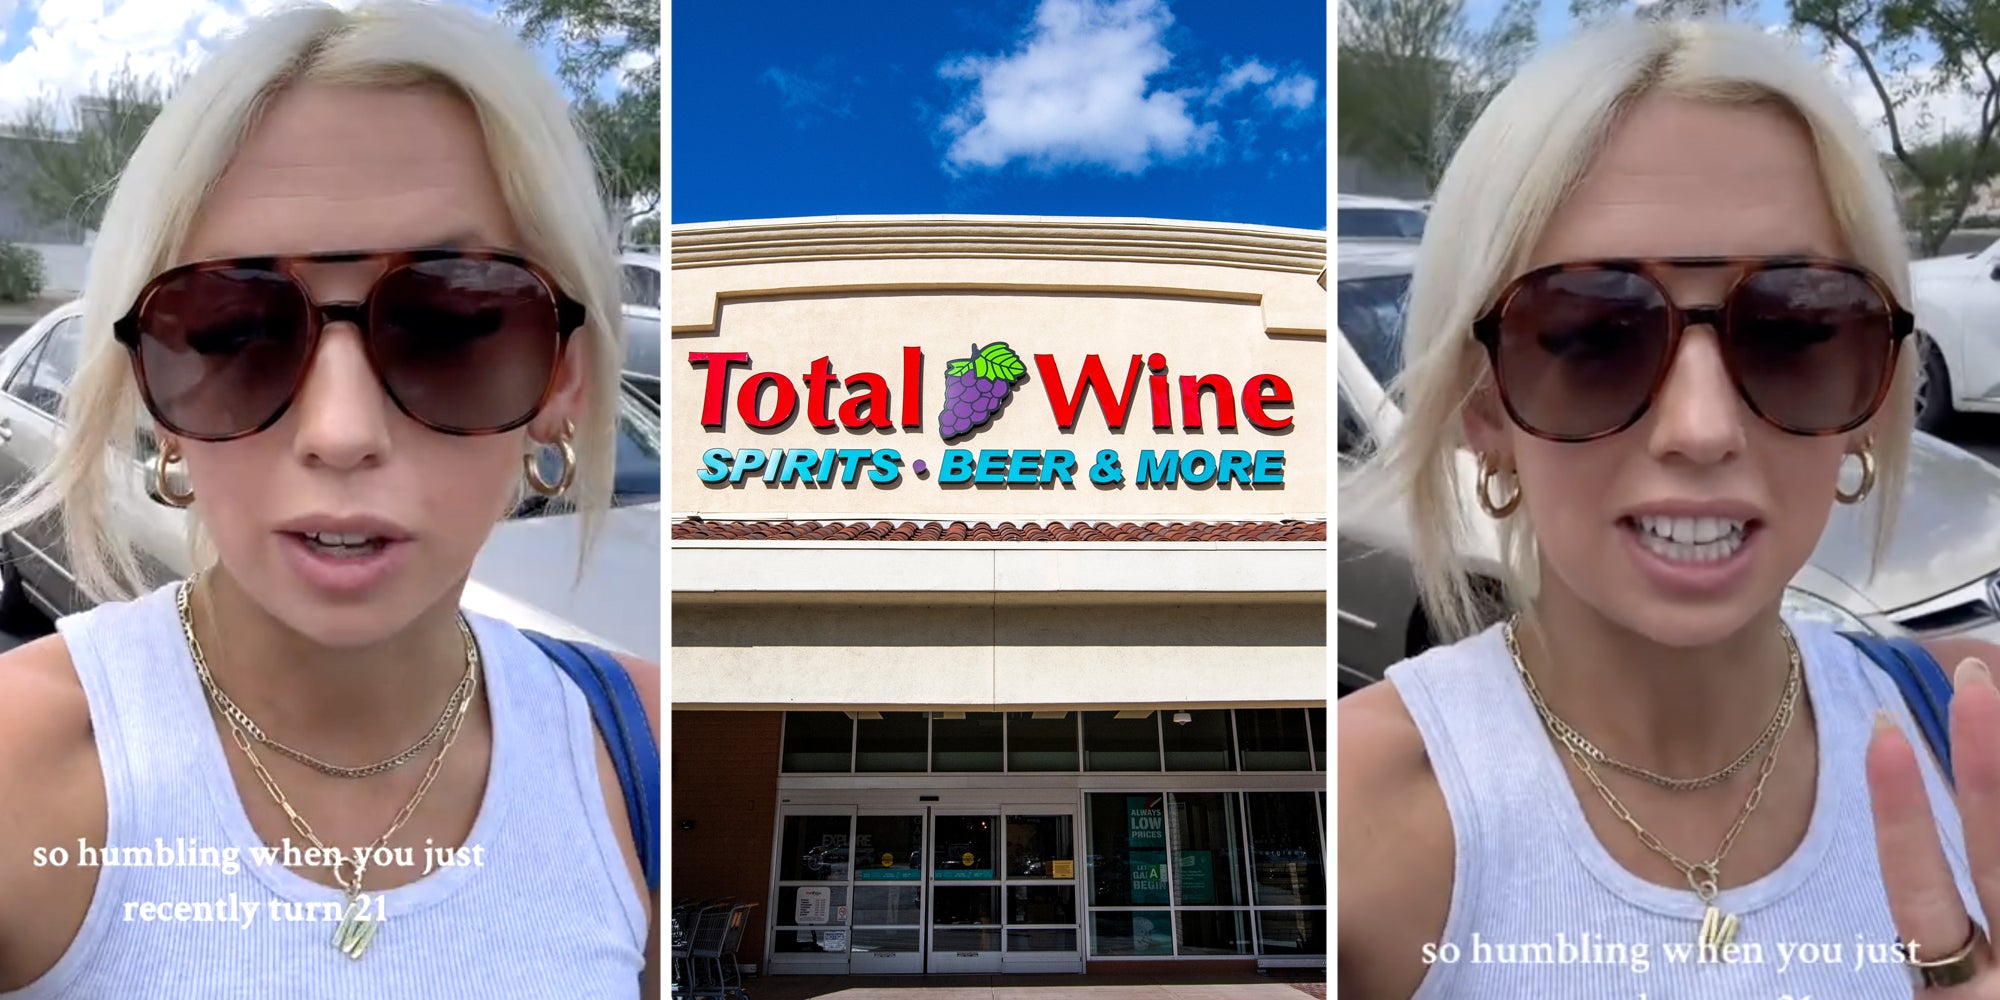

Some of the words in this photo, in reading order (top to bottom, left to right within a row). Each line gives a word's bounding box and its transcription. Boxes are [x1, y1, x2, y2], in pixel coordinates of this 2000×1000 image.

[688, 346, 922, 429] Total
[1034, 352, 1295, 430] Wine
[697, 447, 902, 484] SPIRITS
[938, 448, 1076, 484] BEER
[1088, 448, 1124, 484] &
[1135, 449, 1285, 484] MORE
[1130, 809, 1162, 817] ALWAYS
[1131, 817, 1162, 830] LOW
[822, 834, 872, 847] EXPLRE
[1131, 830, 1162, 839] PRICES
[1149, 868, 1159, 879] A
[1133, 880, 1167, 890] BEGIN
